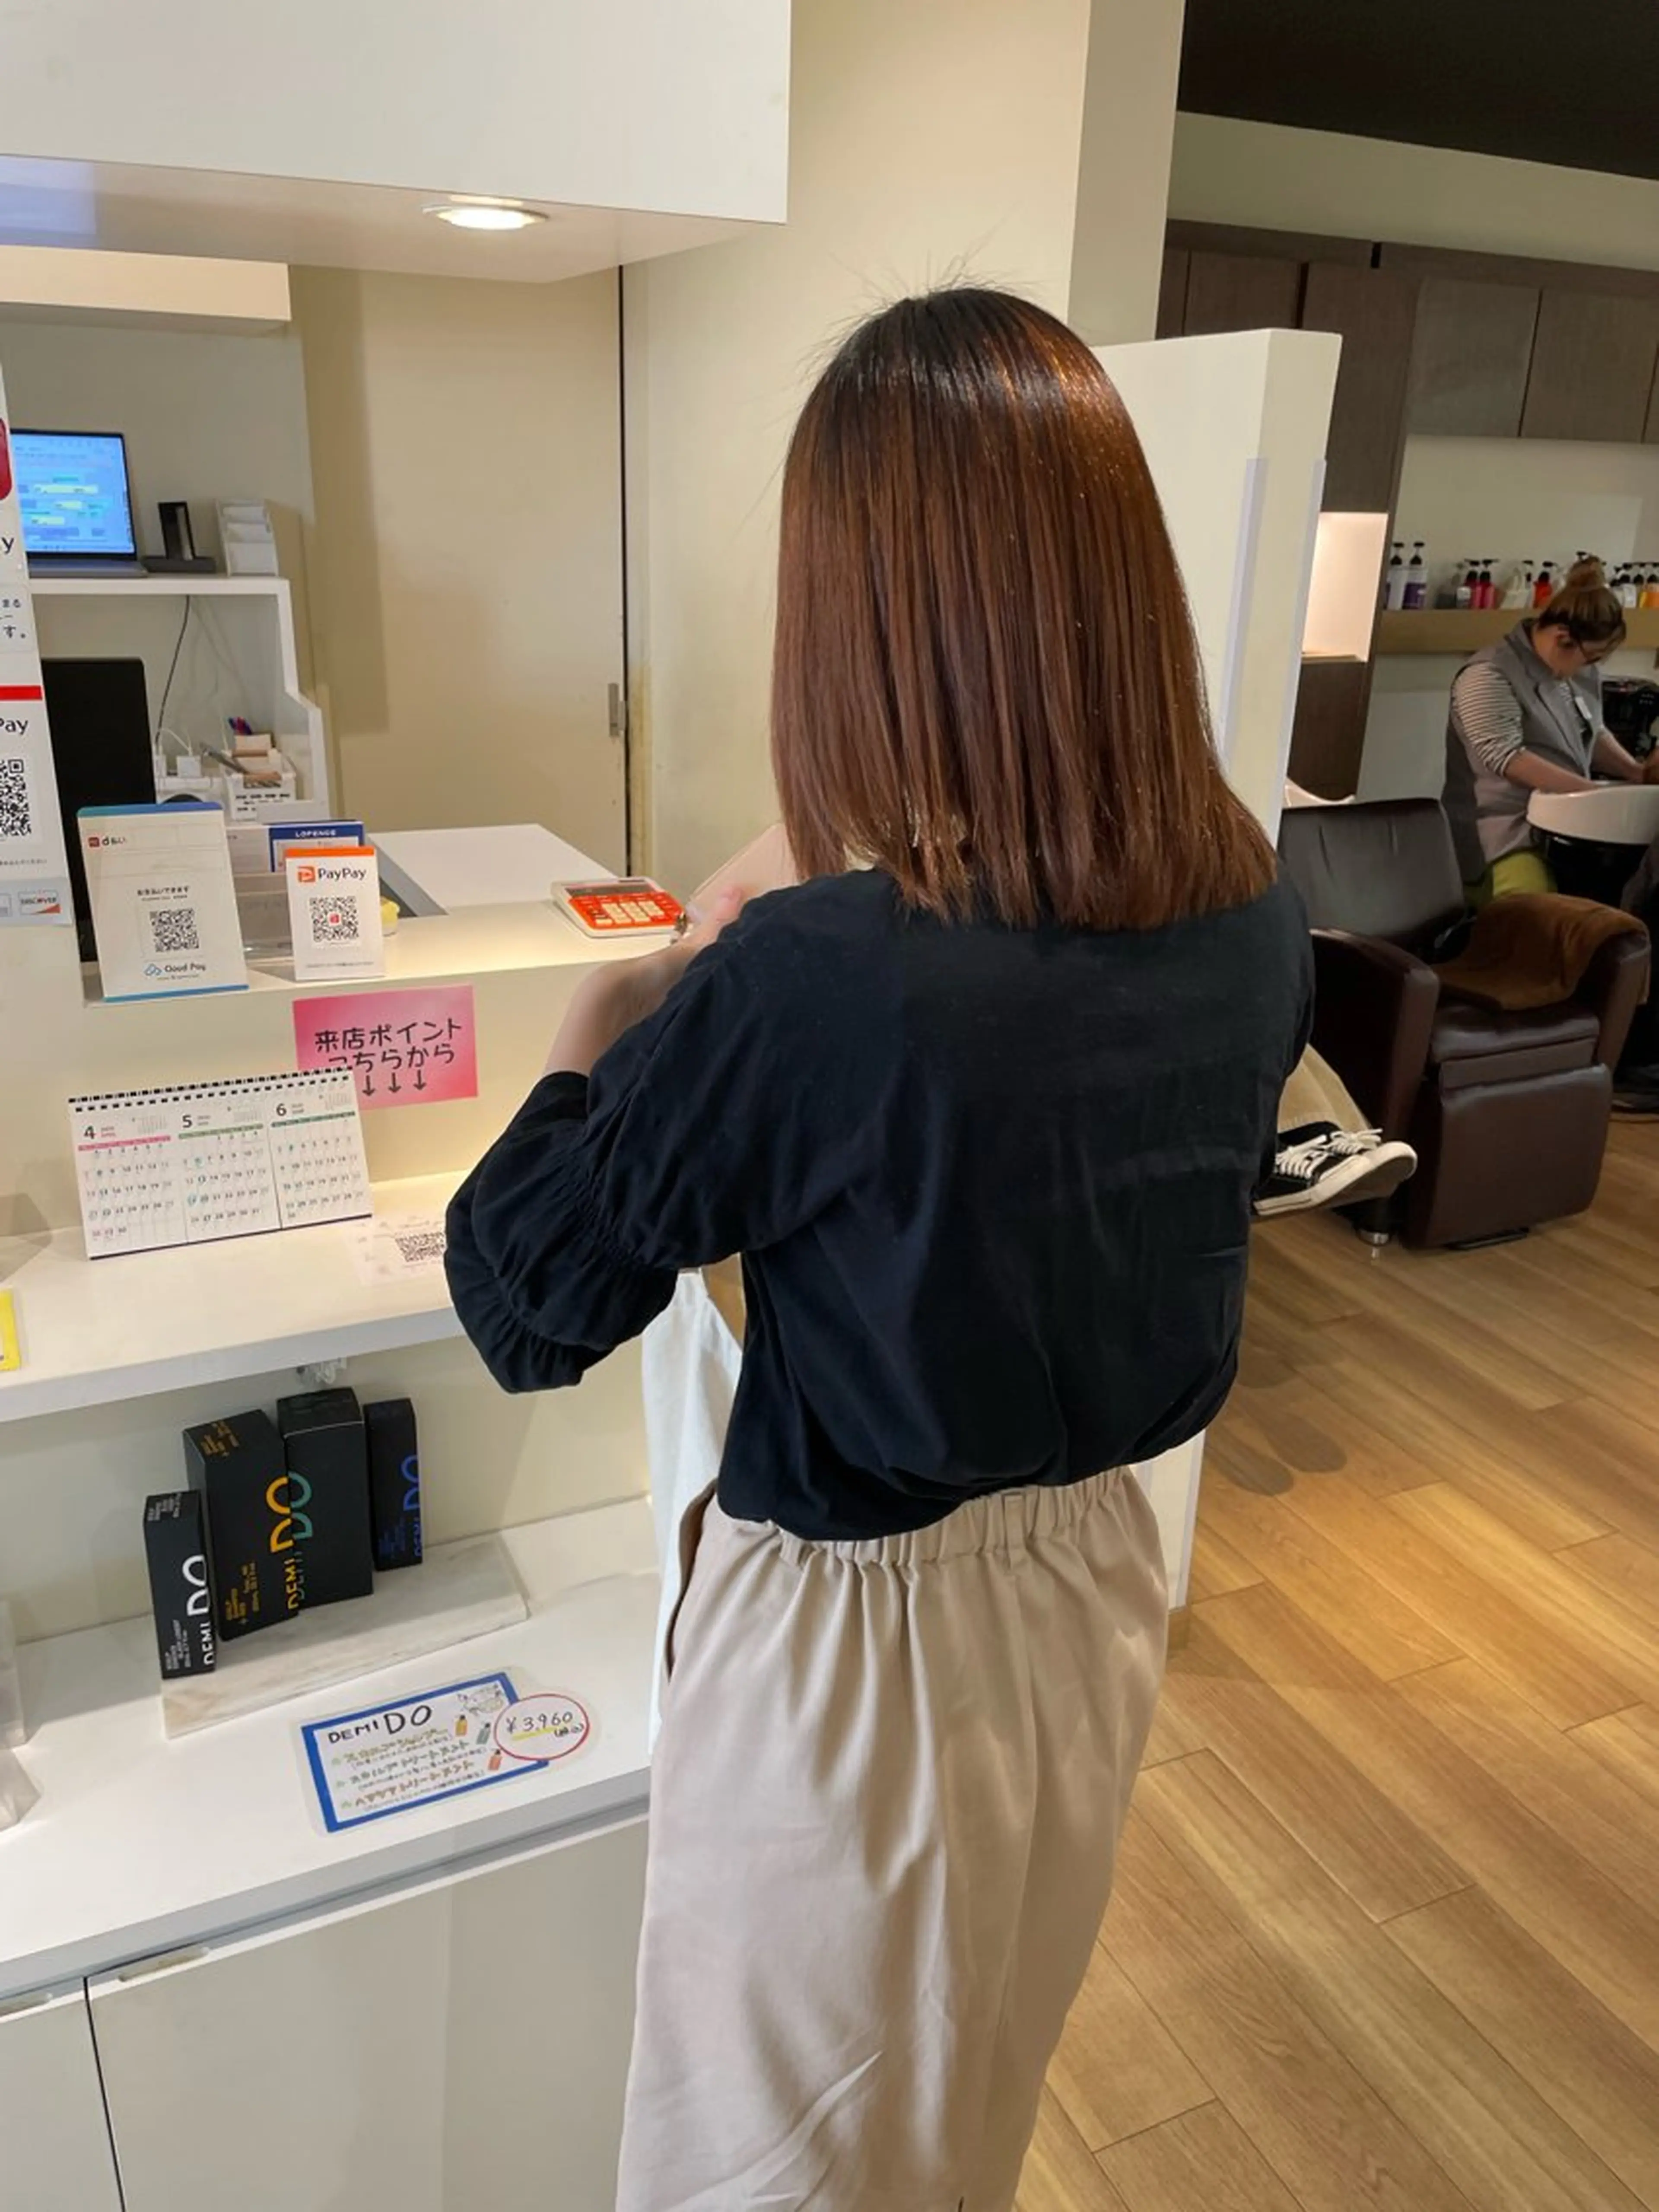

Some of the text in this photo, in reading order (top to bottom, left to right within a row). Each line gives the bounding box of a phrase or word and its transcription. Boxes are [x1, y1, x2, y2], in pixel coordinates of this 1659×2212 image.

[318, 868, 367, 880] PayPay
[314, 1018, 462, 1053] 来店ポイント
[276, 1103, 287, 1116] 6
[182, 1114, 193, 1128] 5
[84, 1125, 95, 1139] 4
[328, 1705, 432, 1744] DEMI DO
